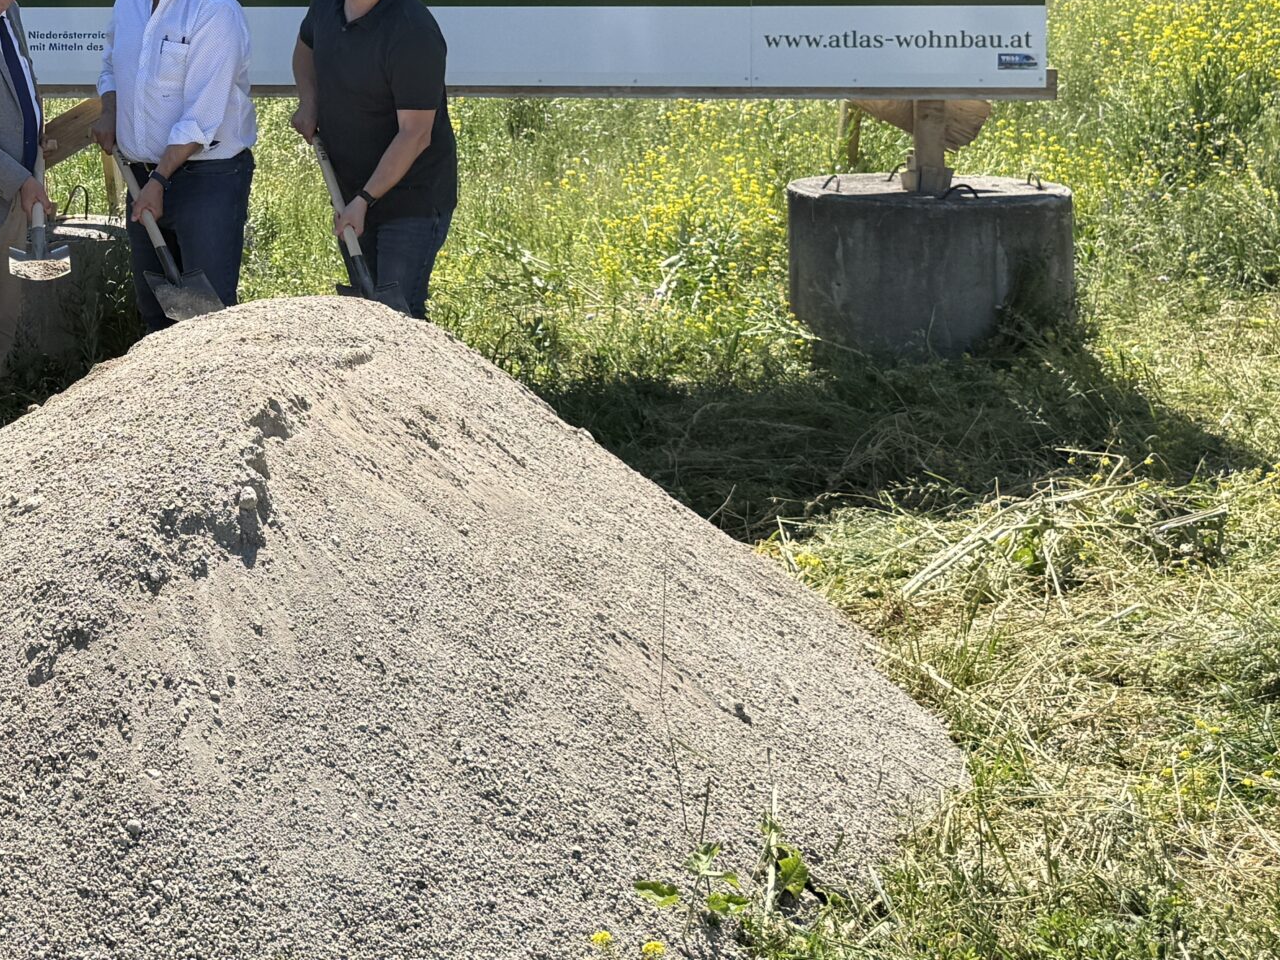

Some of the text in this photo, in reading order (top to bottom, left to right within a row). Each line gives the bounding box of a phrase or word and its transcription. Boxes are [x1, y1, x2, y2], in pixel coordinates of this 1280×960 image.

[28, 30, 107, 40] Niederösterreic
[765, 30, 1033, 50] www.atlas-wohnbau.at
[29, 42, 104, 52] mit Mitteln des
